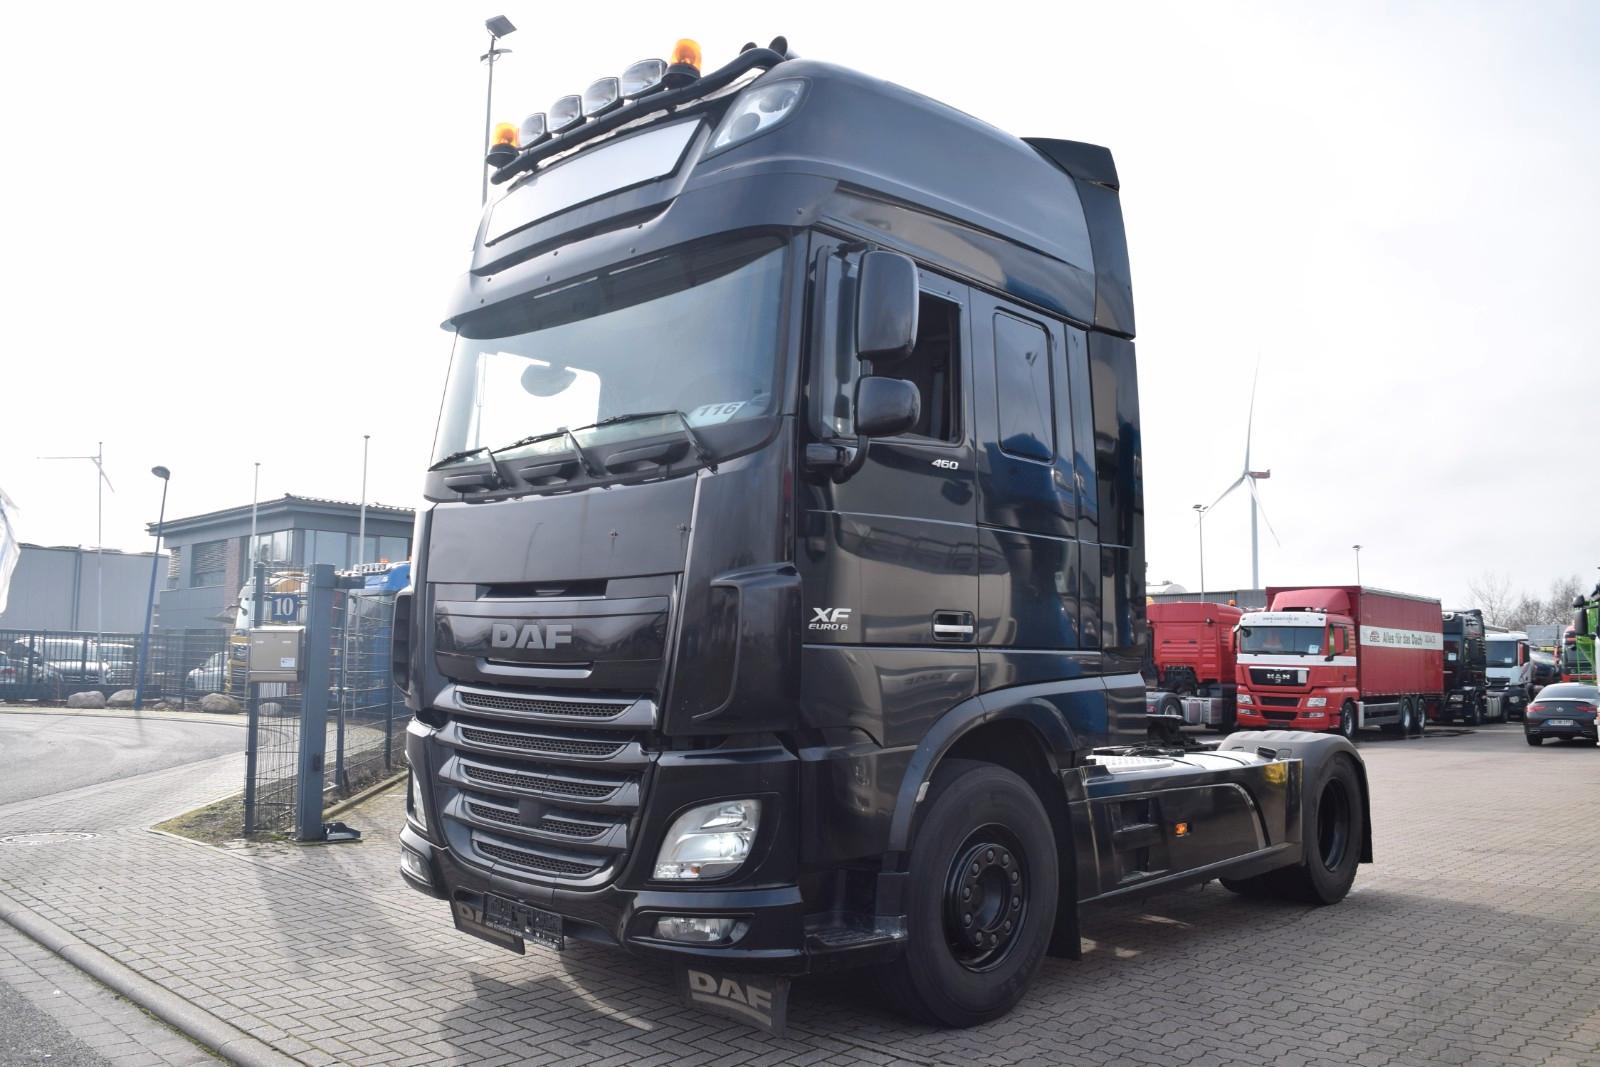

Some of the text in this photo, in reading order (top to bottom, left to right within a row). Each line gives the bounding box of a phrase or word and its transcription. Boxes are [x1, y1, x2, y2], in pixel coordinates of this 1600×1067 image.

[700, 403, 740, 416] 116
[931, 459, 959, 470] 460
[274, 597, 294, 616] 10
[810, 607, 852, 622] XF
[840, 623, 848, 631] 6
[491, 623, 573, 649] DAF
[687, 969, 772, 1009] DAF
